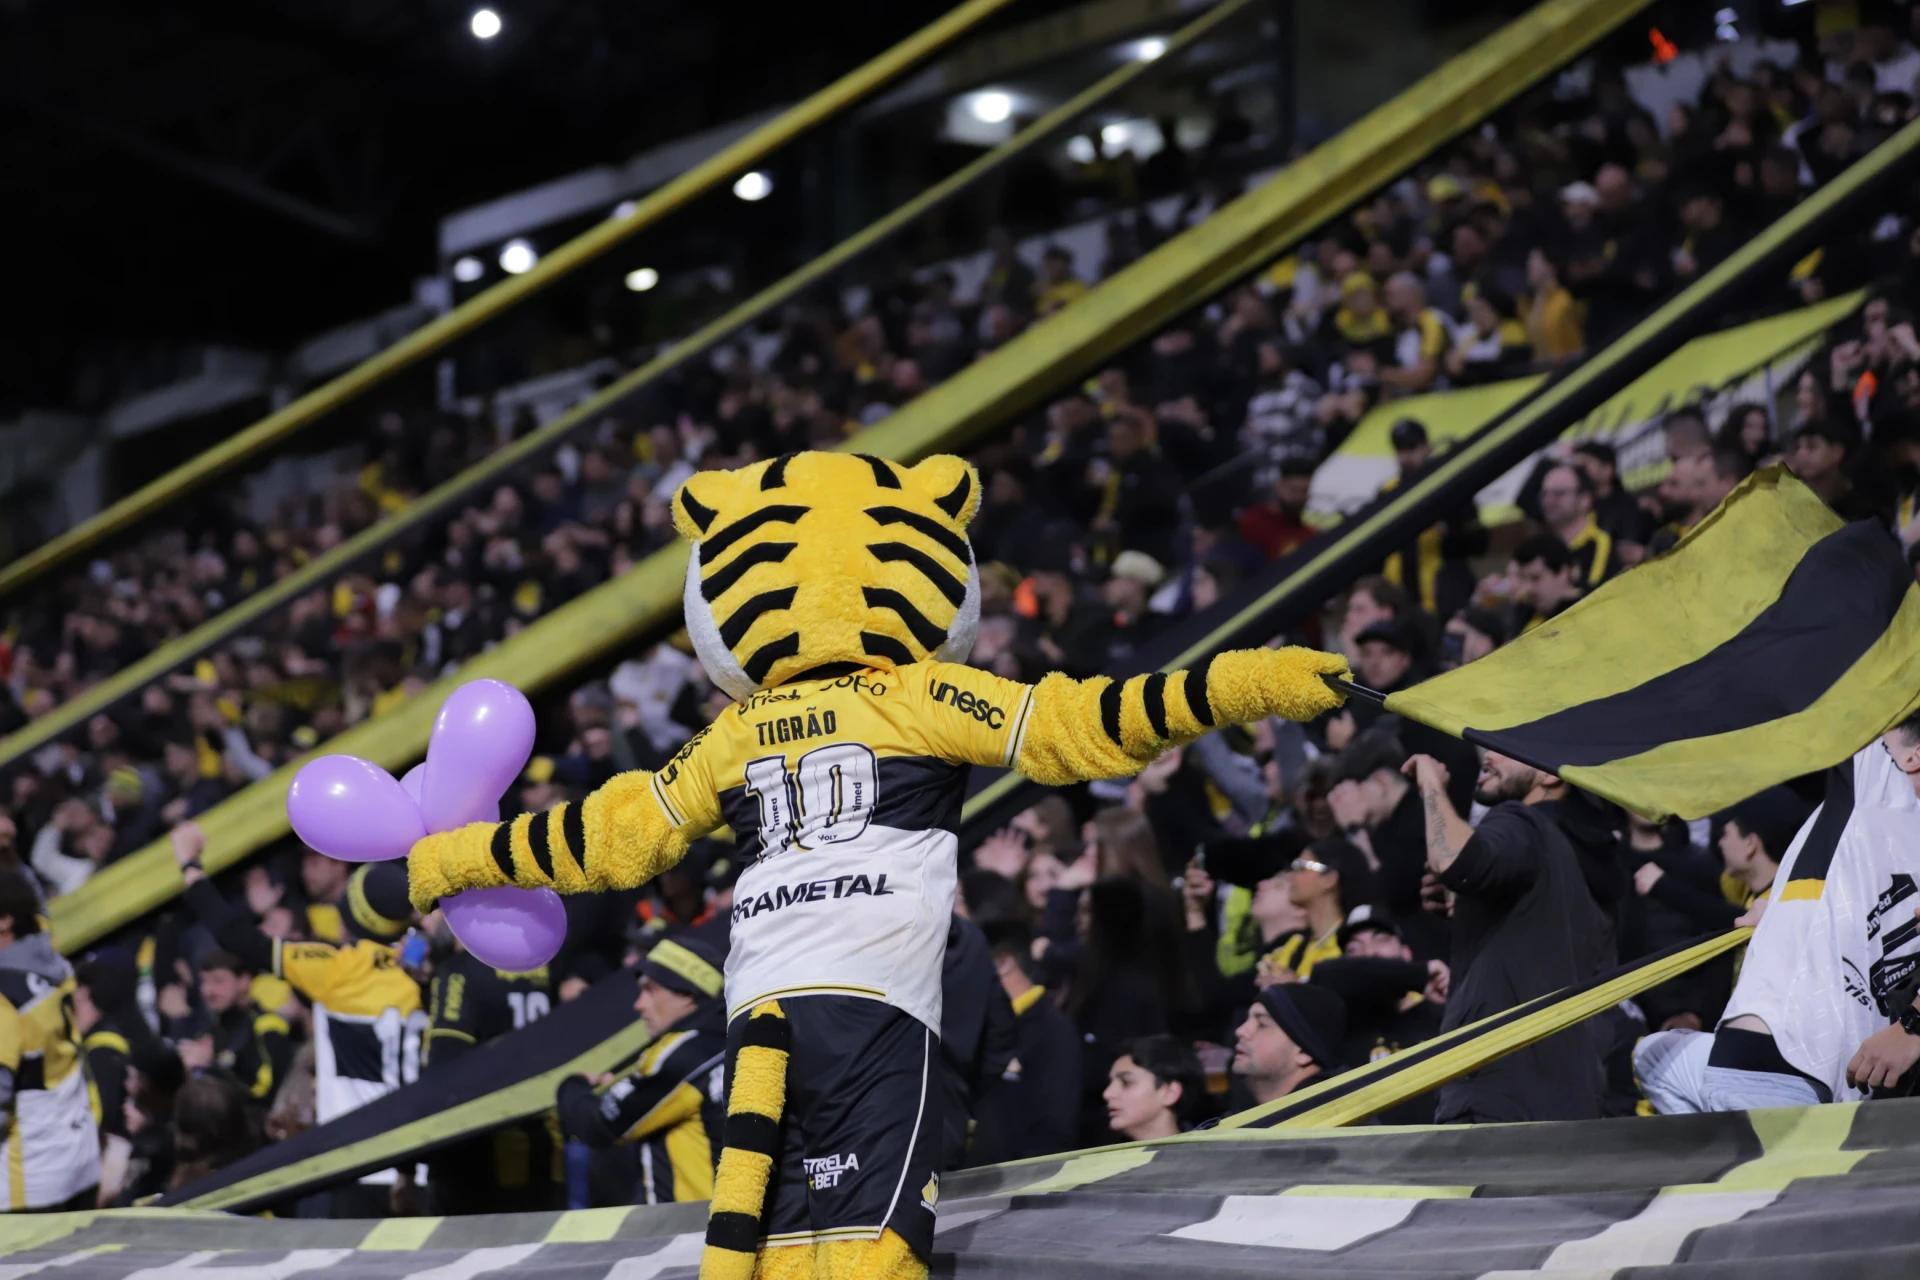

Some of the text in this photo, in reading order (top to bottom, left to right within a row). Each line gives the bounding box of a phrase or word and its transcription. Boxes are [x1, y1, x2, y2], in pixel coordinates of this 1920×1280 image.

[755, 706, 837, 746] TIGRÃO
[929, 678, 1006, 730] unesc
[744, 742, 879, 863] 10
[815, 1170, 842, 1190] BET
